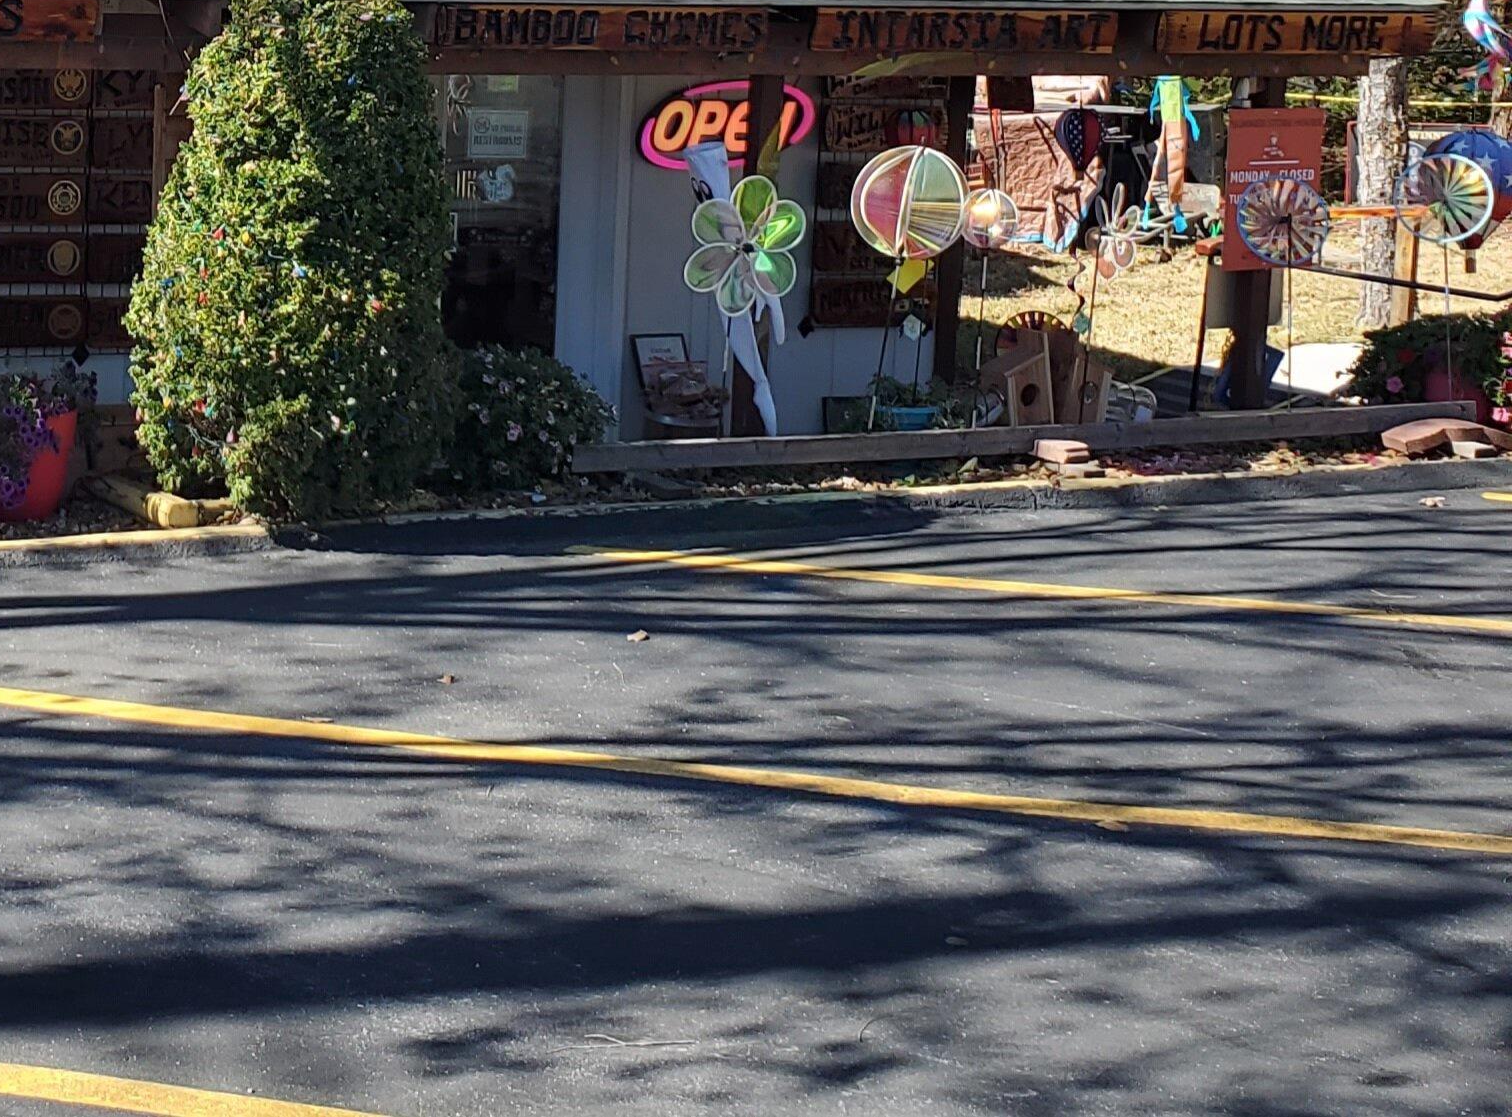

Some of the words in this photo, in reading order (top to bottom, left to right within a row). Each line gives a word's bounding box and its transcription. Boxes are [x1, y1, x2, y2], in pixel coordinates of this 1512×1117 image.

[454, 6, 601, 45] BAMBOO
[623, 9, 767, 49] CHIMES
[831, 9, 1017, 50] INTARSIA
[1039, 12, 1111, 51] ART
[1196, 13, 1286, 51] LOTS
[1300, 13, 1388, 51] MORE
[1229, 170, 1270, 184] MONDAY
[1278, 168, 1315, 182] CLOSED
